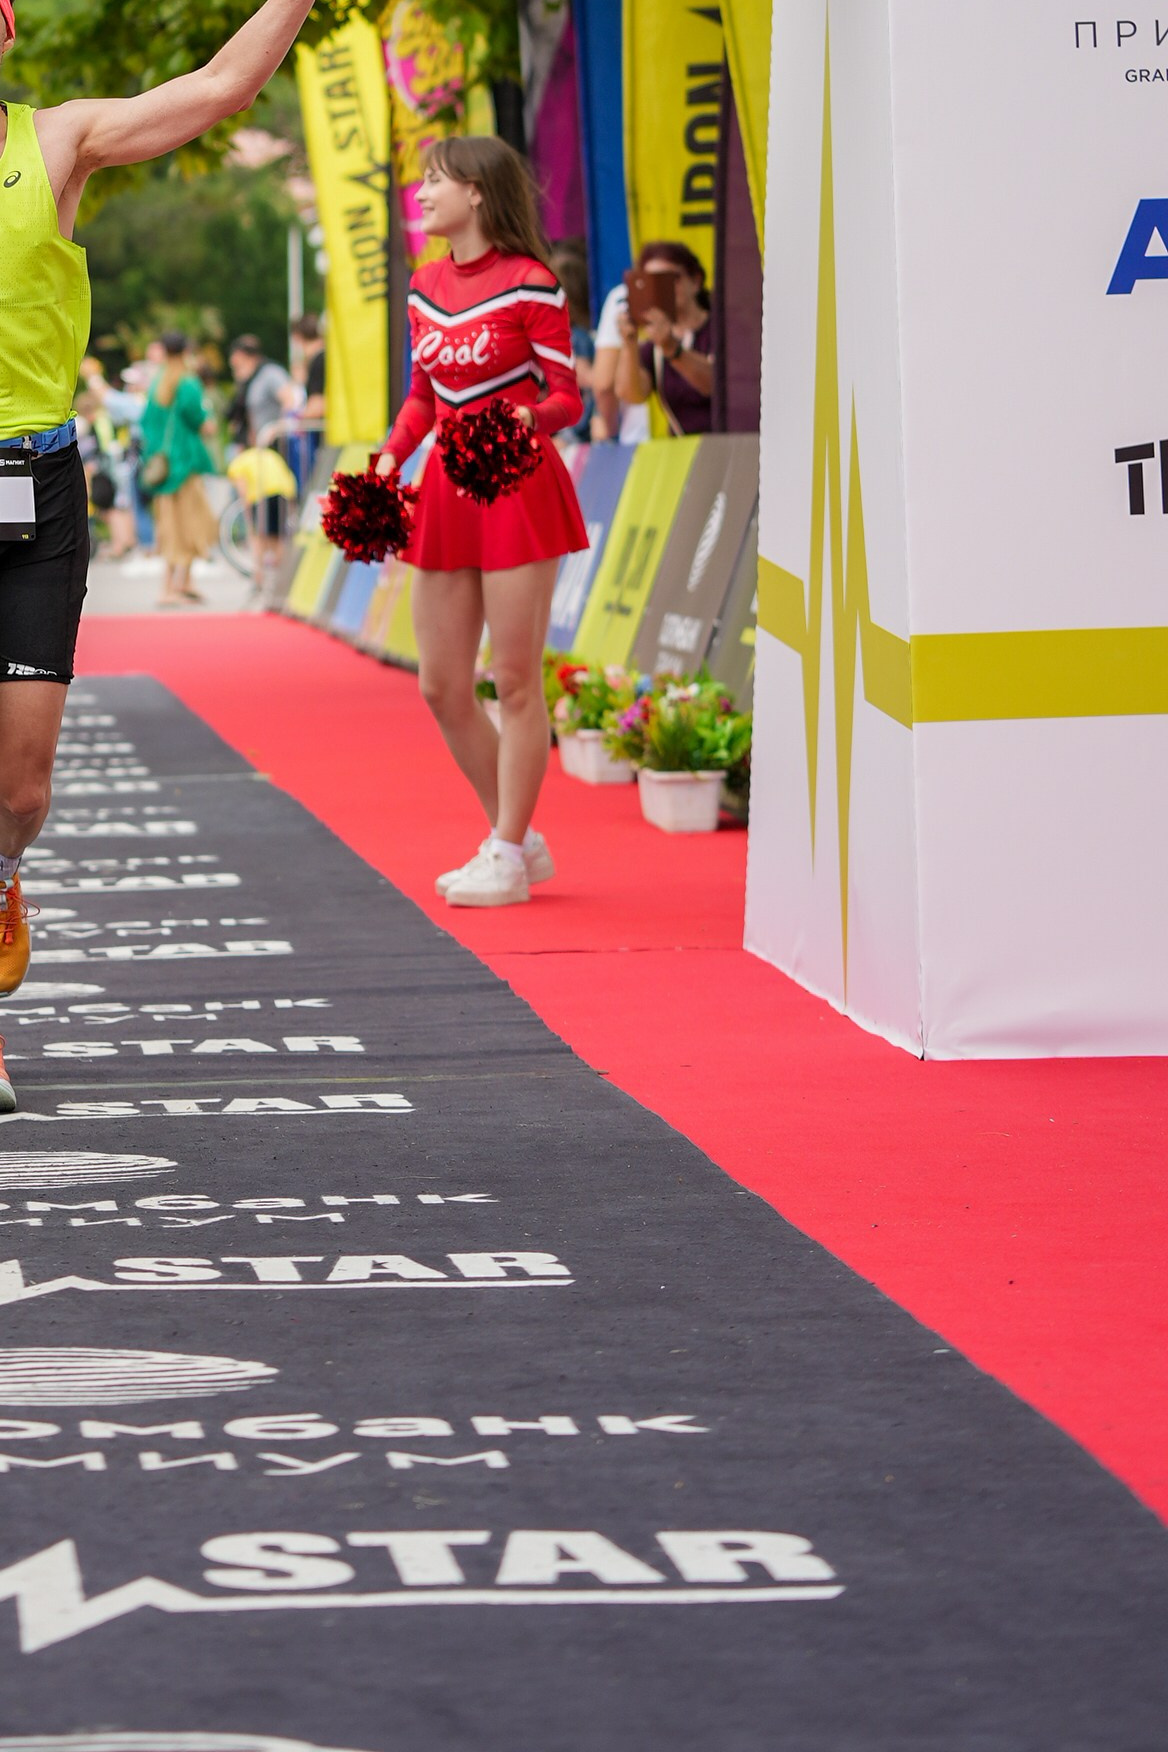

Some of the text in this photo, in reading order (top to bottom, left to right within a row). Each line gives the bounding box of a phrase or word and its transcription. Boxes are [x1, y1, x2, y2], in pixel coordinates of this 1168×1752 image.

[1125, 67, 1168, 84] GRA
[318, 44, 389, 303] IRON STAR
[417, 329, 491, 372] Cool
[30, 940, 294, 959] STAR
[41, 1036, 366, 1058] STAR
[54, 1093, 413, 1116] STAR
[111, 1251, 572, 1283] STAR
[199, 1529, 834, 1591] STAR
